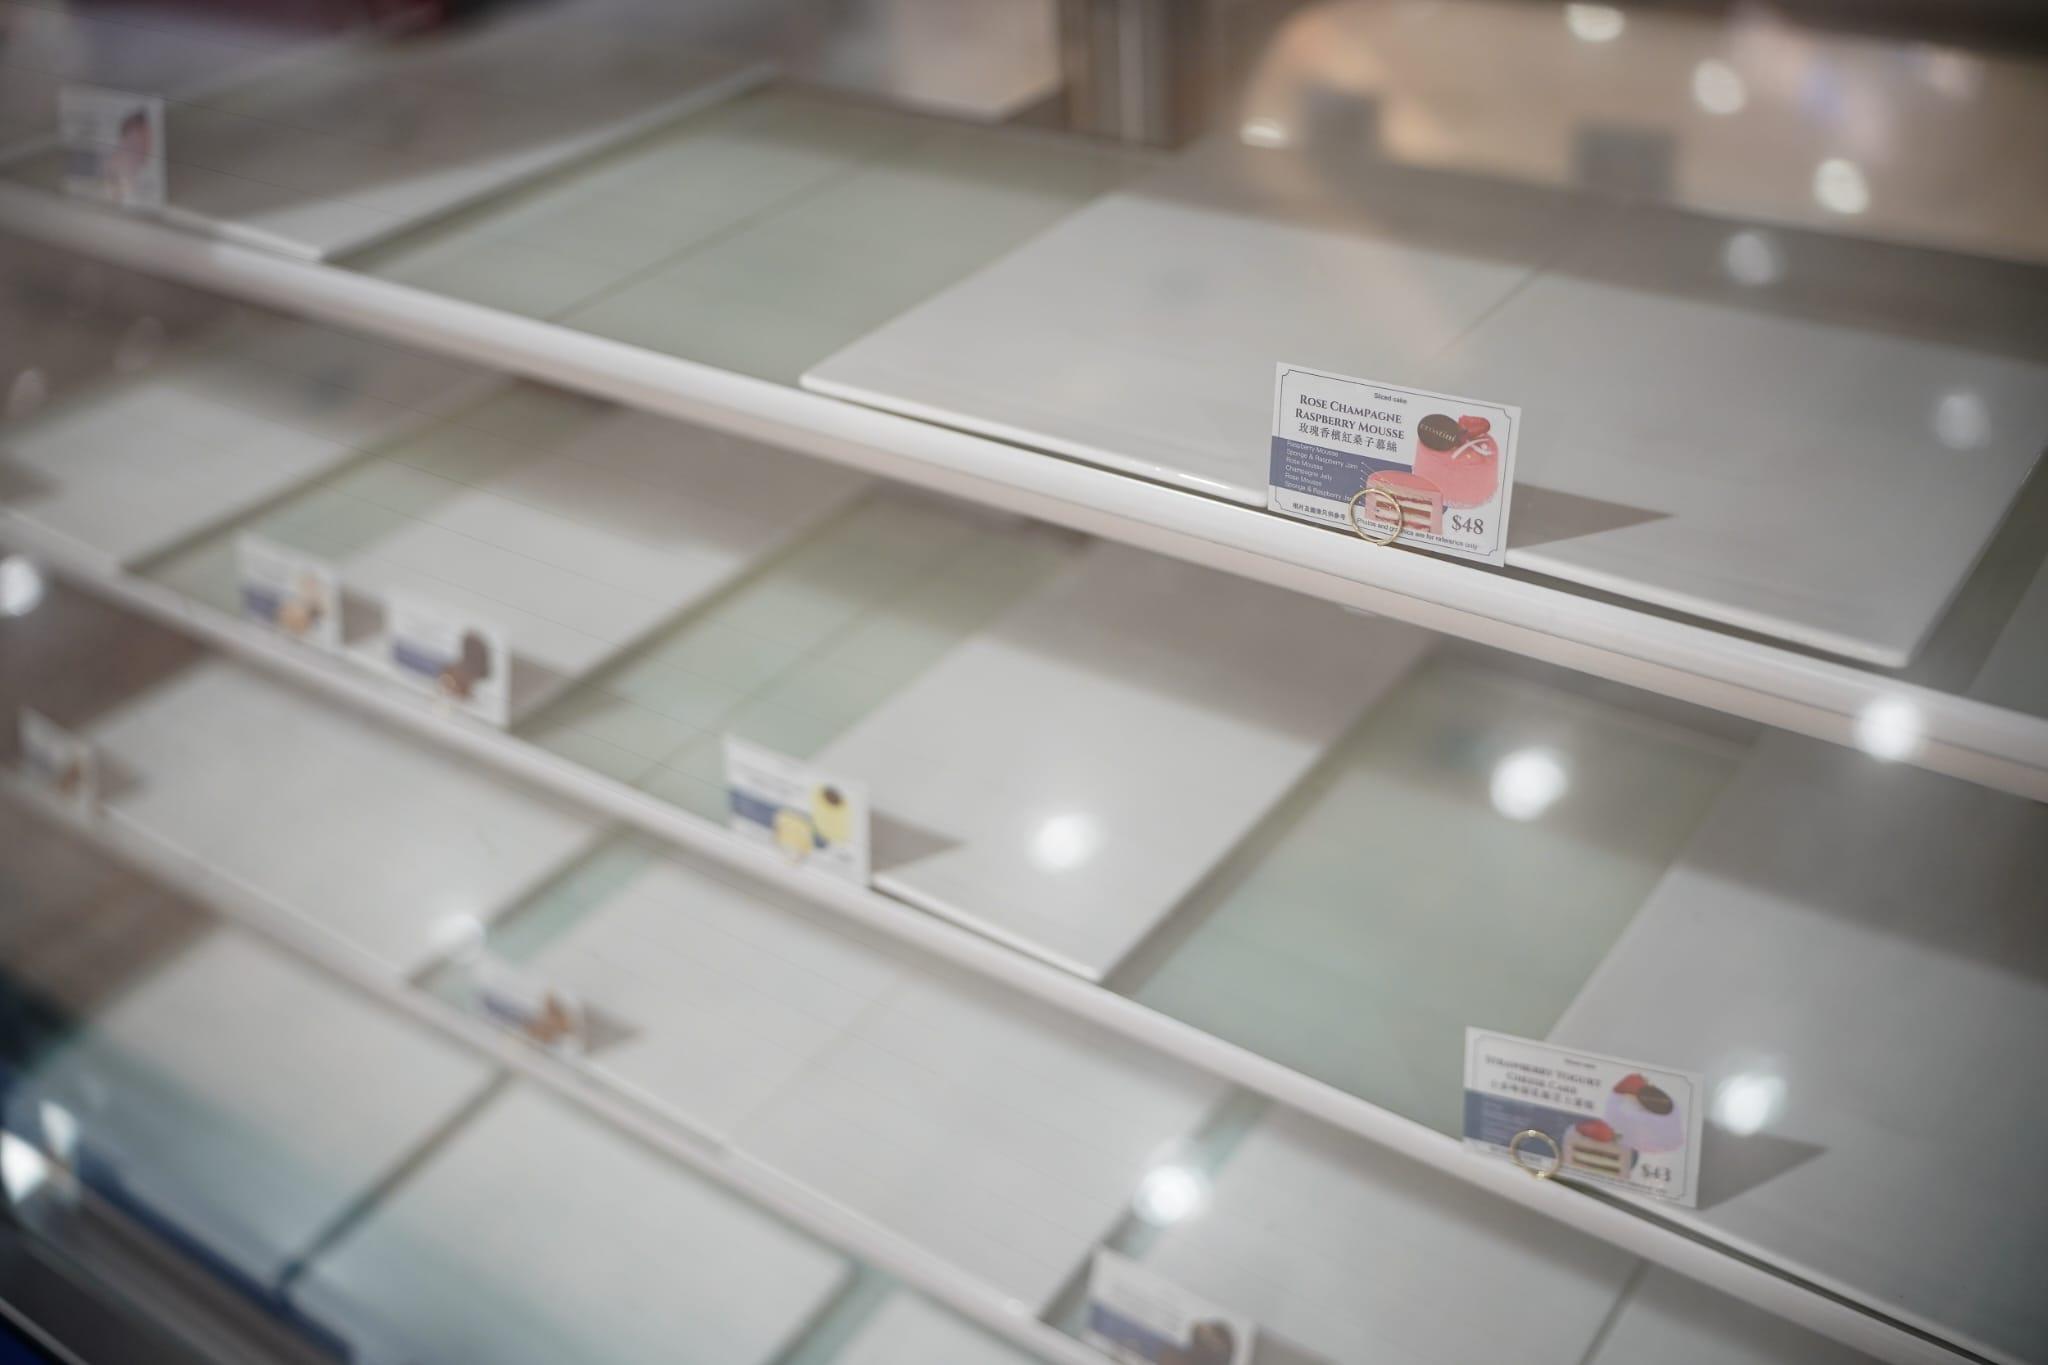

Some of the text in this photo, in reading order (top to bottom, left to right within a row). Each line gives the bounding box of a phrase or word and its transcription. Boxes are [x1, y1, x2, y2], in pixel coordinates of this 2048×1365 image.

[1299, 394, 1402, 424] ROSE CHAMPAGNE
[1374, 392, 1408, 404] Sliced cake
[1295, 408, 1405, 439] RASPBERRY MOUSSE
[1452, 514, 1484, 535] $48
